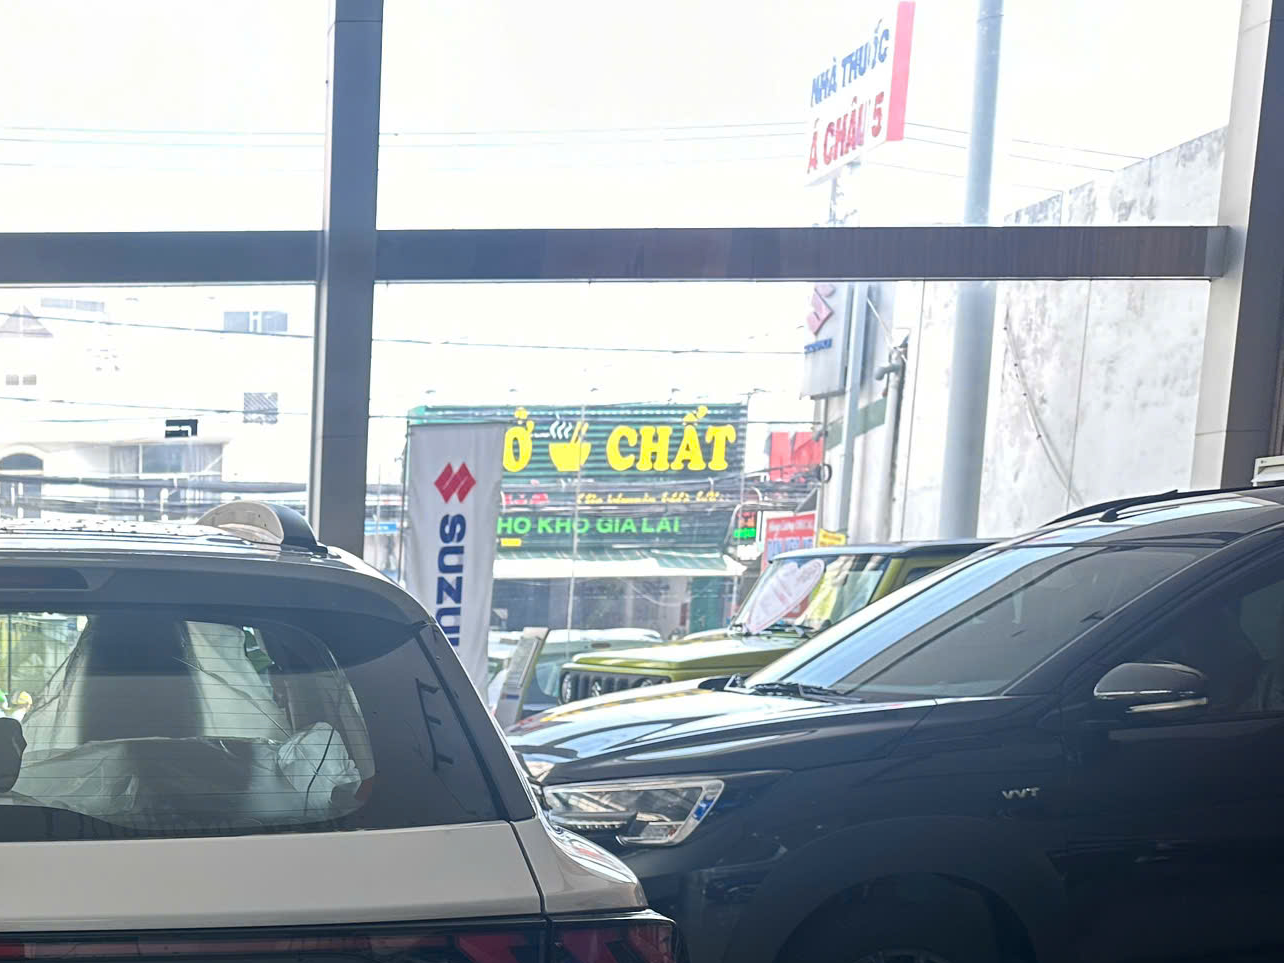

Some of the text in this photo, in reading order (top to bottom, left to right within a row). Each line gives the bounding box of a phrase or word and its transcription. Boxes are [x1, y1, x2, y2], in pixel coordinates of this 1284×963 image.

[810, 58, 838, 107] NHÀ
[807, 91, 885, 175] Á CHÂU 5
[605, 404, 737, 472] CHẤT
[596, 517, 637, 534] GIA
[641, 517, 681, 534] LAI
[1001, 786, 1041, 800] VVT
